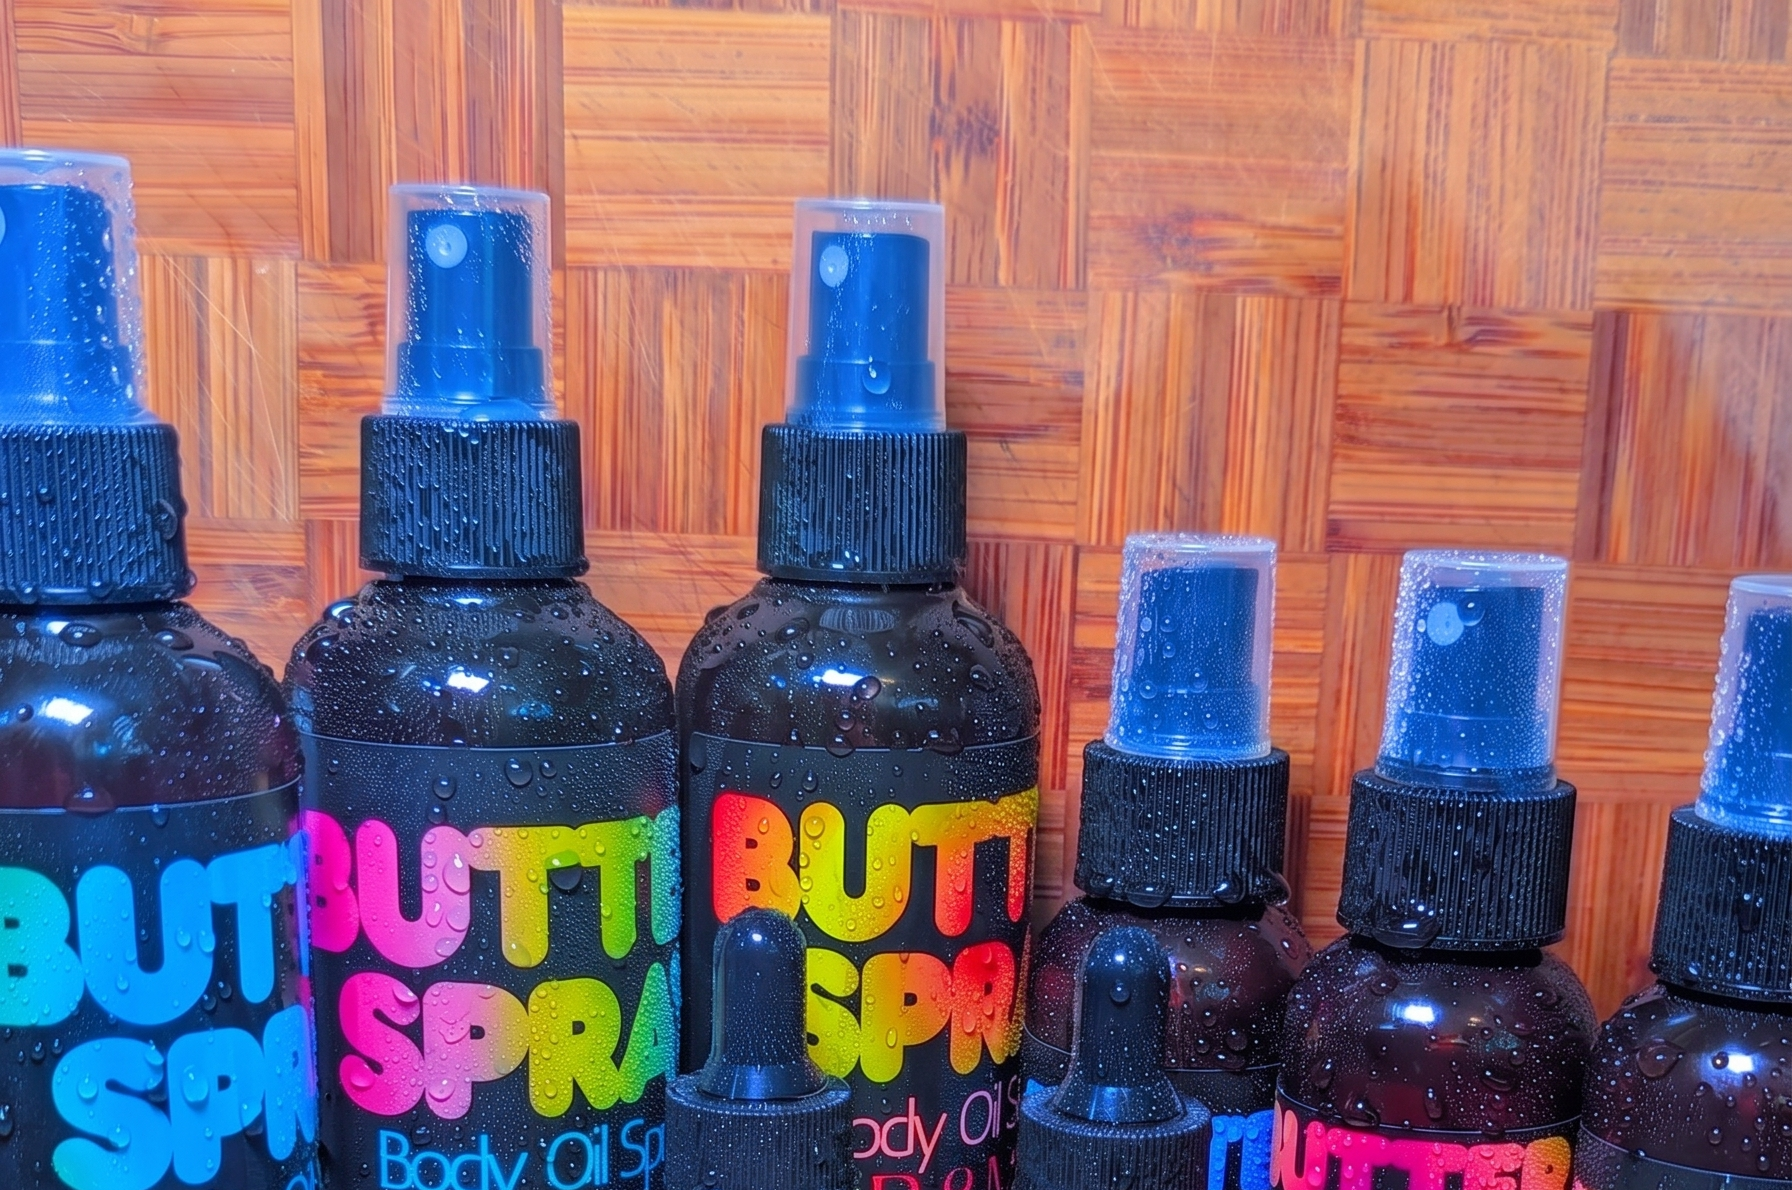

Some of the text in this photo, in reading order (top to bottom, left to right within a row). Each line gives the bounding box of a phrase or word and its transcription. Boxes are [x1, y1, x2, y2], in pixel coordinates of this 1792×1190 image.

[338, 950, 682, 1120] SPRA
[853, 1097, 947, 1174] ody
[960, 1080, 1001, 1146] Oil
